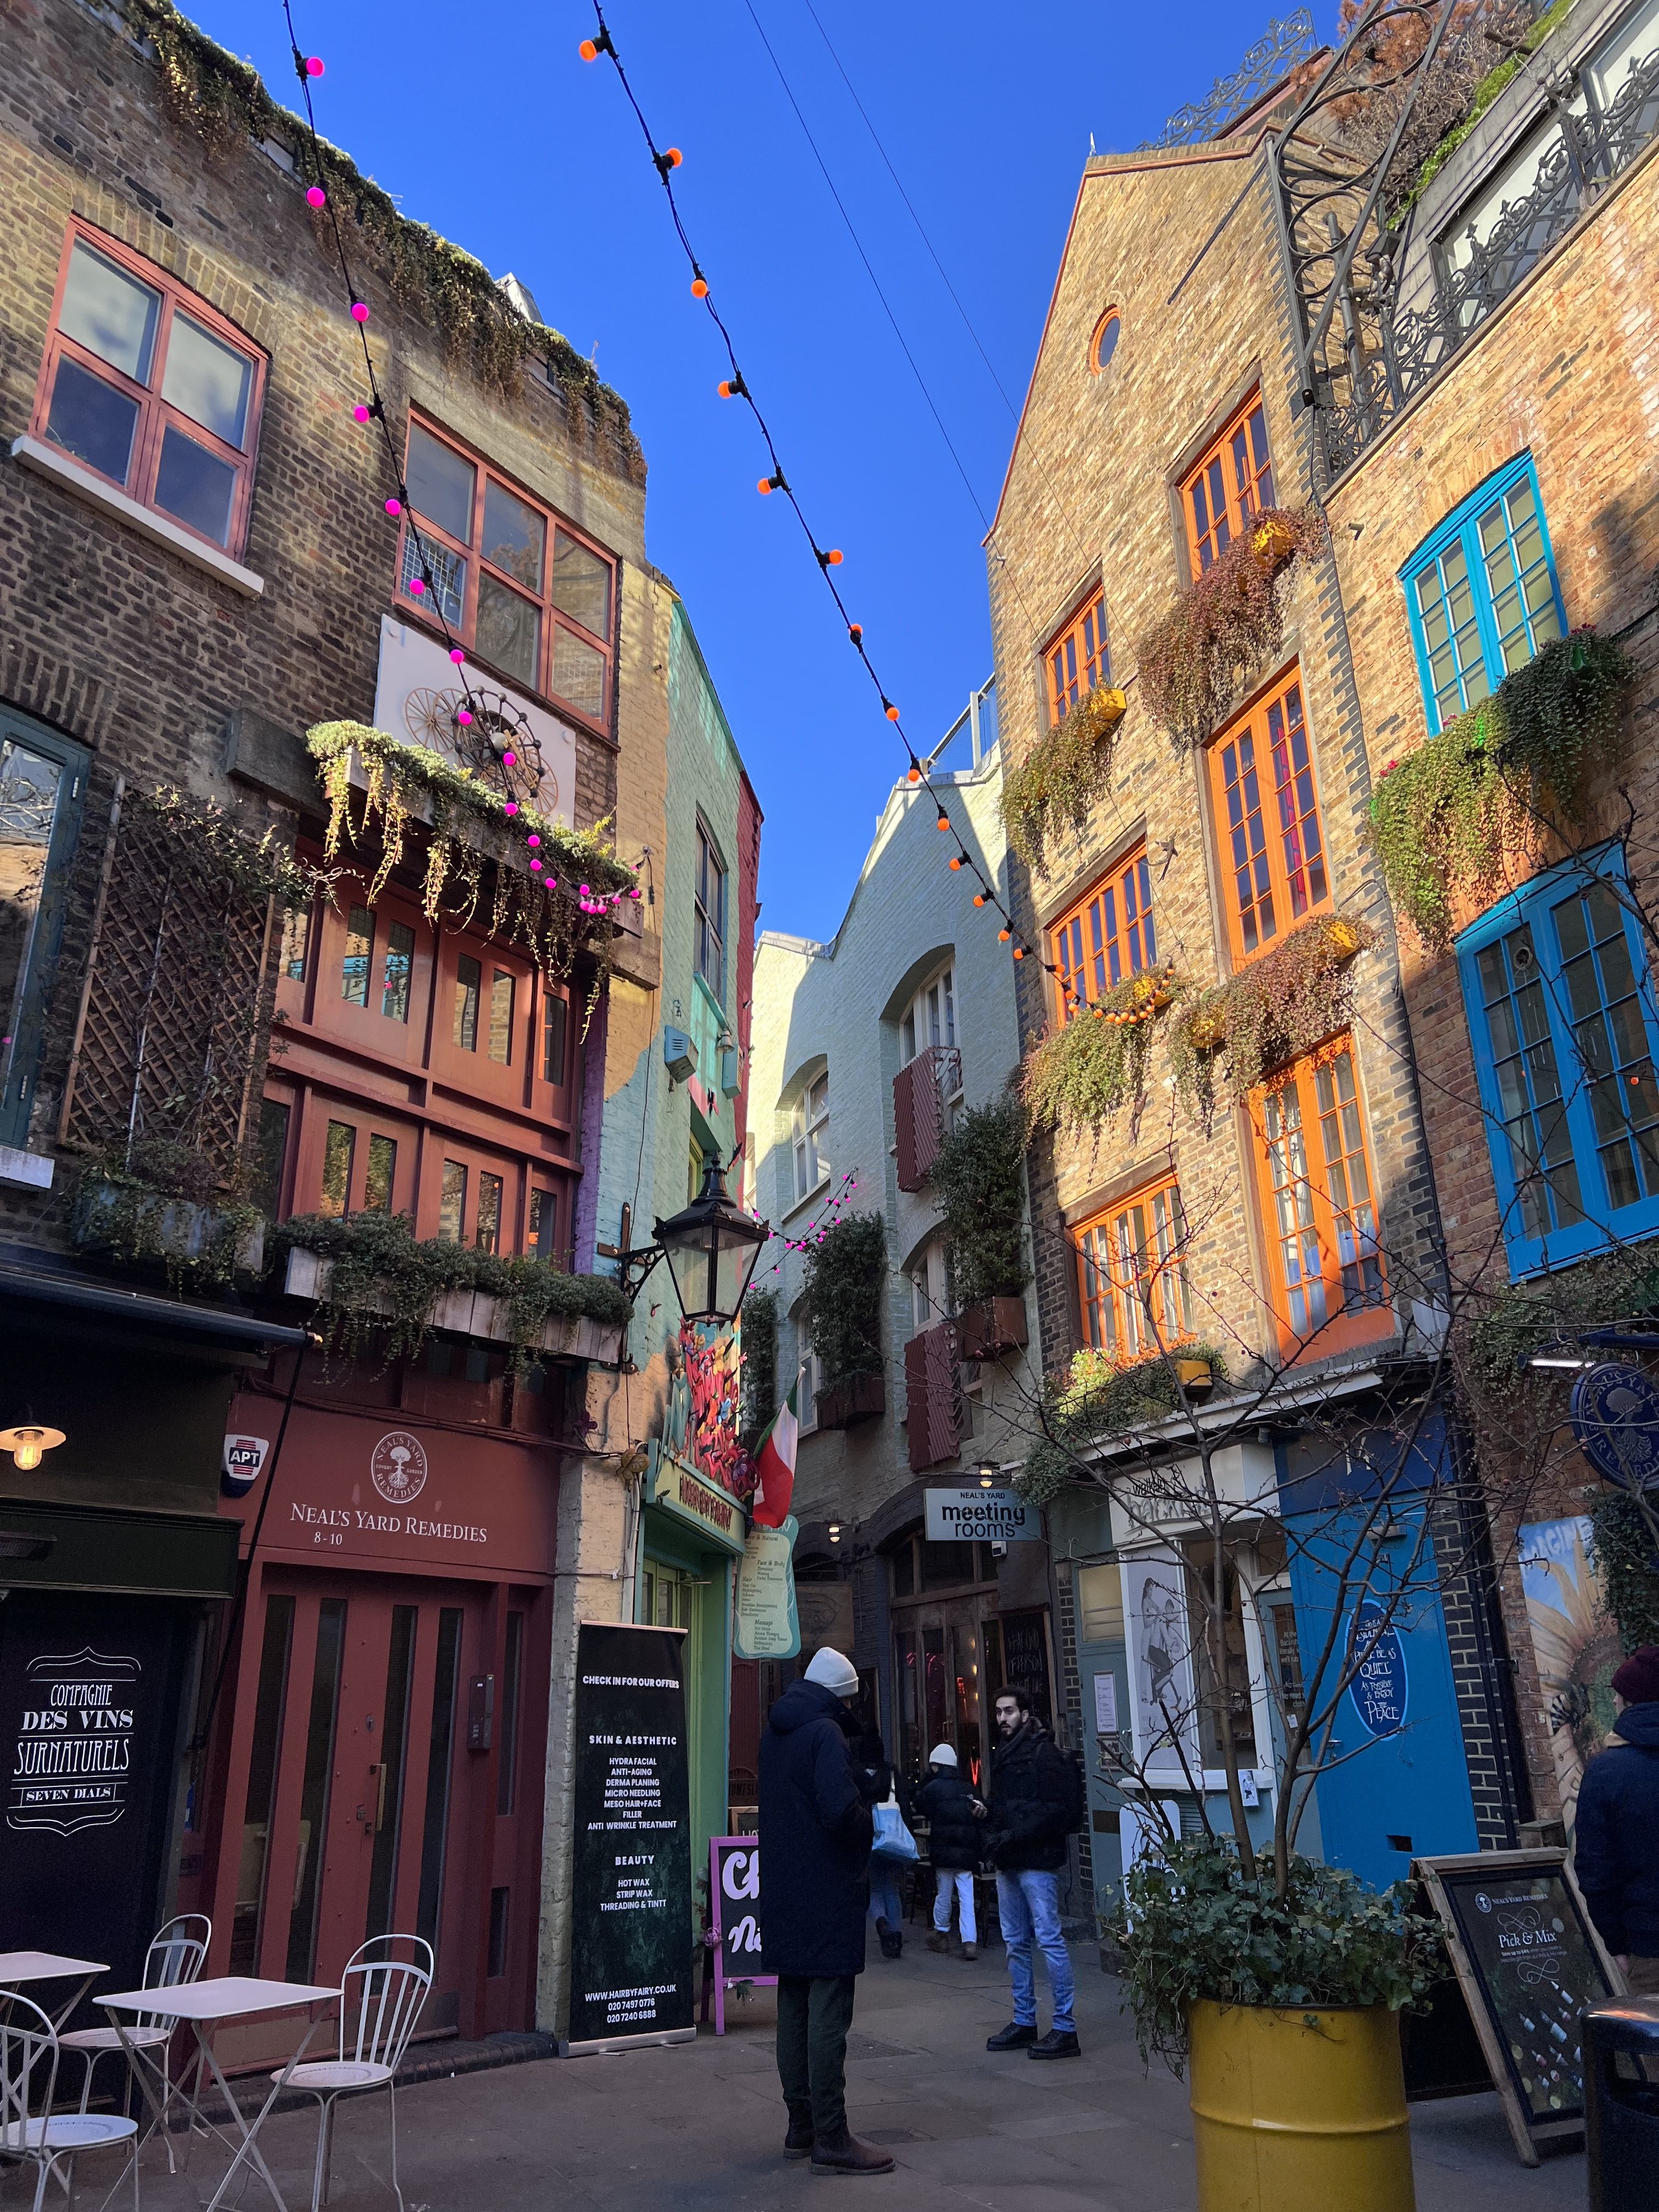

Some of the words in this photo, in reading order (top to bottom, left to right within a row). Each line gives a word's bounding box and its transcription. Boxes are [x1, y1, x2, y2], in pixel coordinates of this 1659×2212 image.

[230, 1450, 259, 1464] APT
[376, 1437, 404, 1460] NEAL'S
[407, 1440, 423, 1467] YARD
[377, 1473, 421, 1498] REMEDIES
[942, 1502, 1025, 1526] meeting
[290, 1503, 351, 1527] NEAL'S
[355, 1510, 400, 1532] YARD
[404, 1516, 487, 1542] REMEDIES
[955, 1523, 1015, 1537] rooms
[1360, 1662, 1392, 1680] QUIET
[583, 1675, 612, 1685] CHECK
[612, 1677, 621, 1685] IN
[622, 1677, 638, 1686] FOR
[639, 1678, 654, 1687] OUR
[655, 1679, 679, 1689] OFFERS
[50, 1684, 112, 1706] COMPAGNIE
[21, 1711, 68, 1730] DES
[79, 1709, 133, 1729] VINS
[1364, 1701, 1399, 1724] PEACE
[589, 1735, 613, 1744] SKIN
[615, 1735, 622, 1744] &
[625, 1735, 677, 1745] AESTHETIC
[14, 1739, 129, 1775] SURNATURELS
[634, 1757, 657, 1765] FACIAL
[26, 1789, 70, 1801] SEVEN
[74, 1787, 111, 1798] DIALS
[605, 1789, 628, 1797] MICRO
[625, 1799, 662, 1808] HAIR+FACE
[588, 1822, 604, 1830] ANTI
[606, 1821, 636, 1830] WRINKLE
[639, 1820, 677, 1829] TREATMENT
[615, 1855, 654, 1866] BEAUTY
[618, 1878, 632, 1887] HOT
[633, 1878, 650, 1886] WAX
[616, 1890, 635, 1899] STRIP
[636, 1889, 653, 1898] WAX
[600, 1901, 640, 1911] THREADING
[640, 1900, 646, 1909] &
[647, 1899, 667, 1908] TINTT
[1498, 1933, 1521, 1948] Pick
[1522, 1932, 1533, 1945] &
[1535, 1929, 1557, 1943] Mix
[585, 1984, 676, 2001] WWW.HAIRBYFAIRY.CO.UK
[608, 2001, 621, 2011] 020
[622, 2000, 638, 2009] 7497
[639, 1998, 655, 2007] 0776
[607, 2013, 620, 2023] 020
[620, 2012, 637, 2022] 7240
[639, 2010, 656, 2018] 6888
